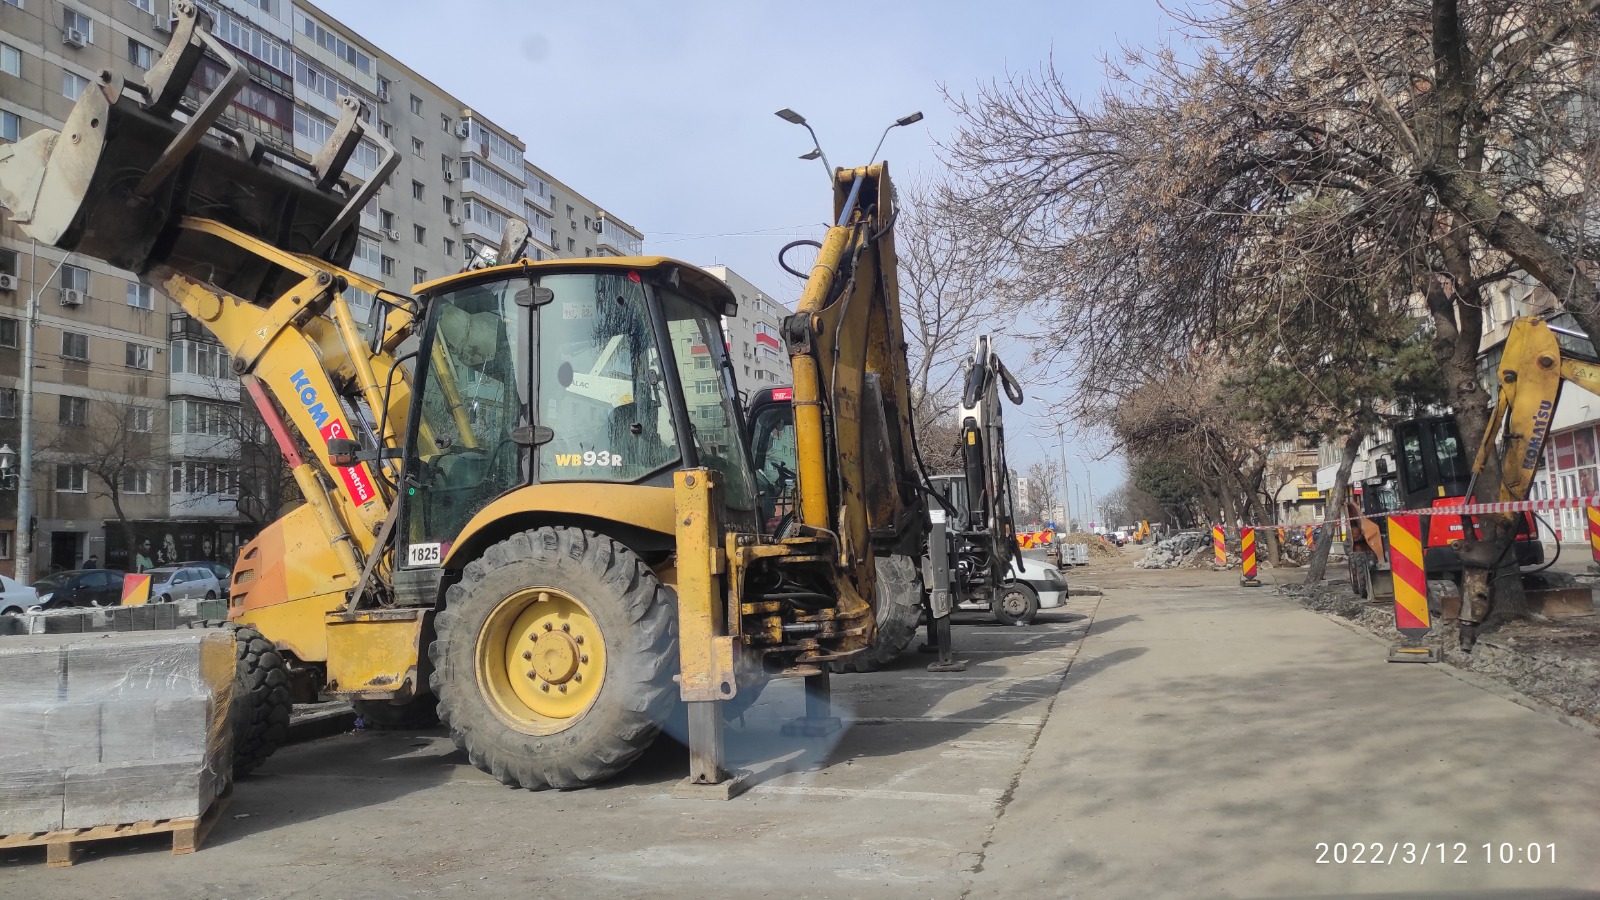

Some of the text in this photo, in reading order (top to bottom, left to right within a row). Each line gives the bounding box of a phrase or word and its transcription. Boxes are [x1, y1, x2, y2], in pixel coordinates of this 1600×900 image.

[1522, 399, 1553, 470] KOMATSU
[555, 450, 623, 467] WB93R
[411, 546, 439, 561] 1825
